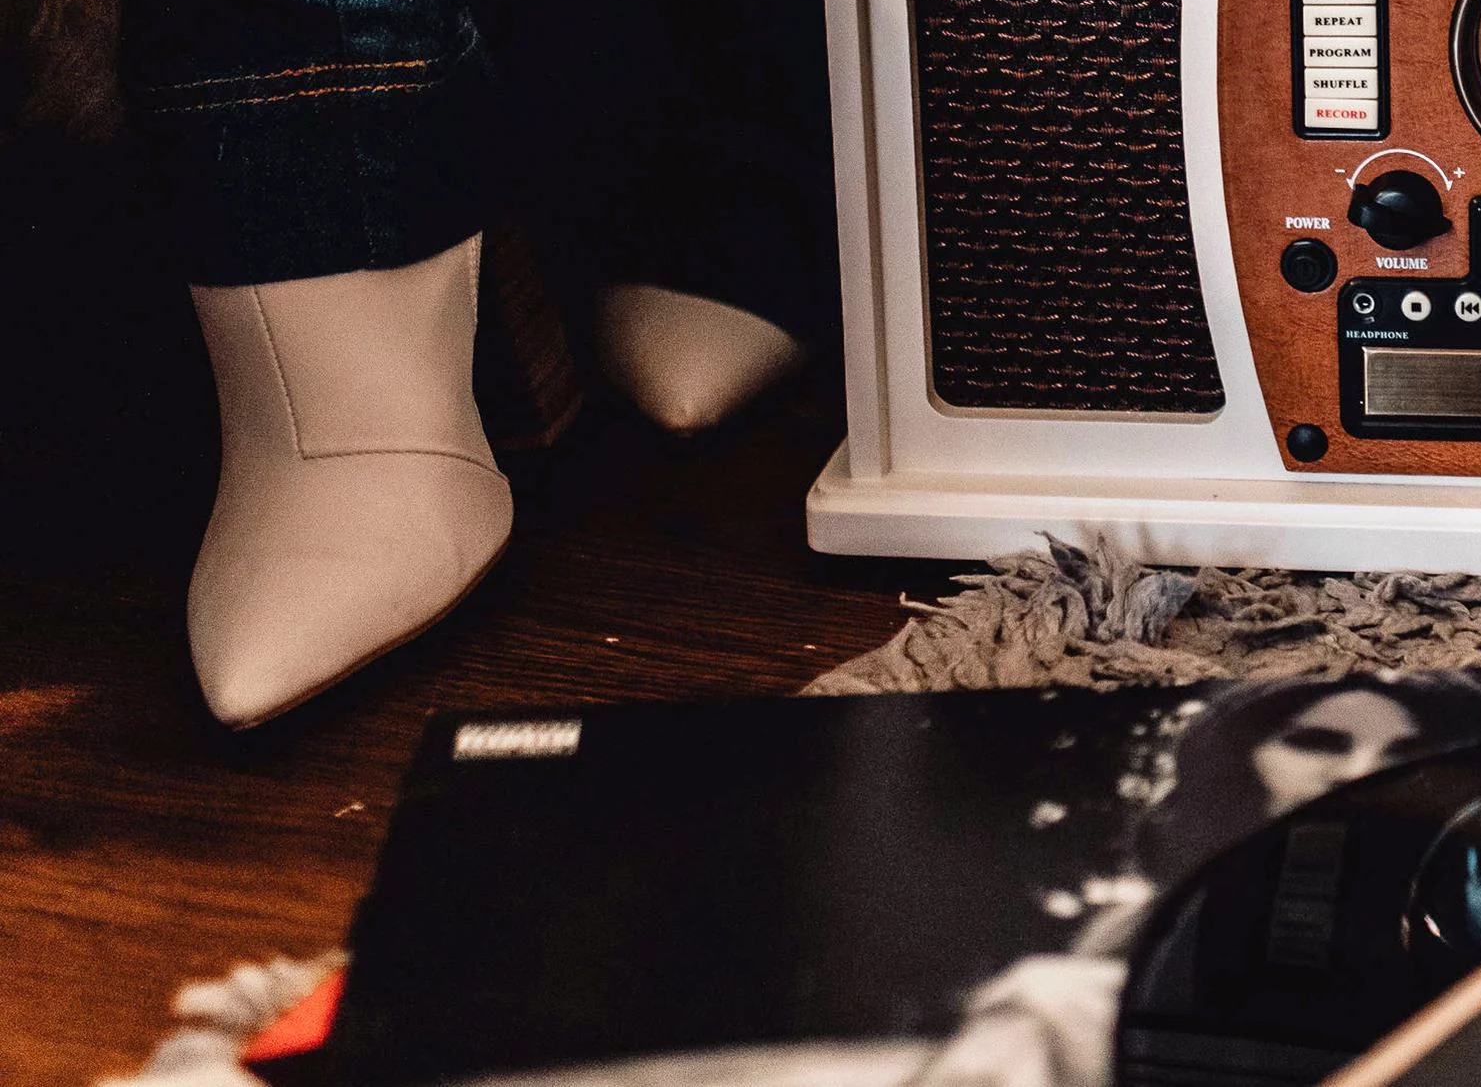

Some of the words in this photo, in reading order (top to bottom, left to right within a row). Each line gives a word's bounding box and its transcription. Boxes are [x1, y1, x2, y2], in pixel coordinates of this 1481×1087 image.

[1314, 17, 1363, 26] REPEAT
[1309, 48, 1372, 57] PROGRAM
[1313, 79, 1368, 89] SHUFFLE
[1316, 109, 1367, 120] RECORD
[1285, 216, 1331, 229] POWER
[1375, 257, 1429, 270] VOLUME
[1346, 330, 1409, 340] HEADPHONE
